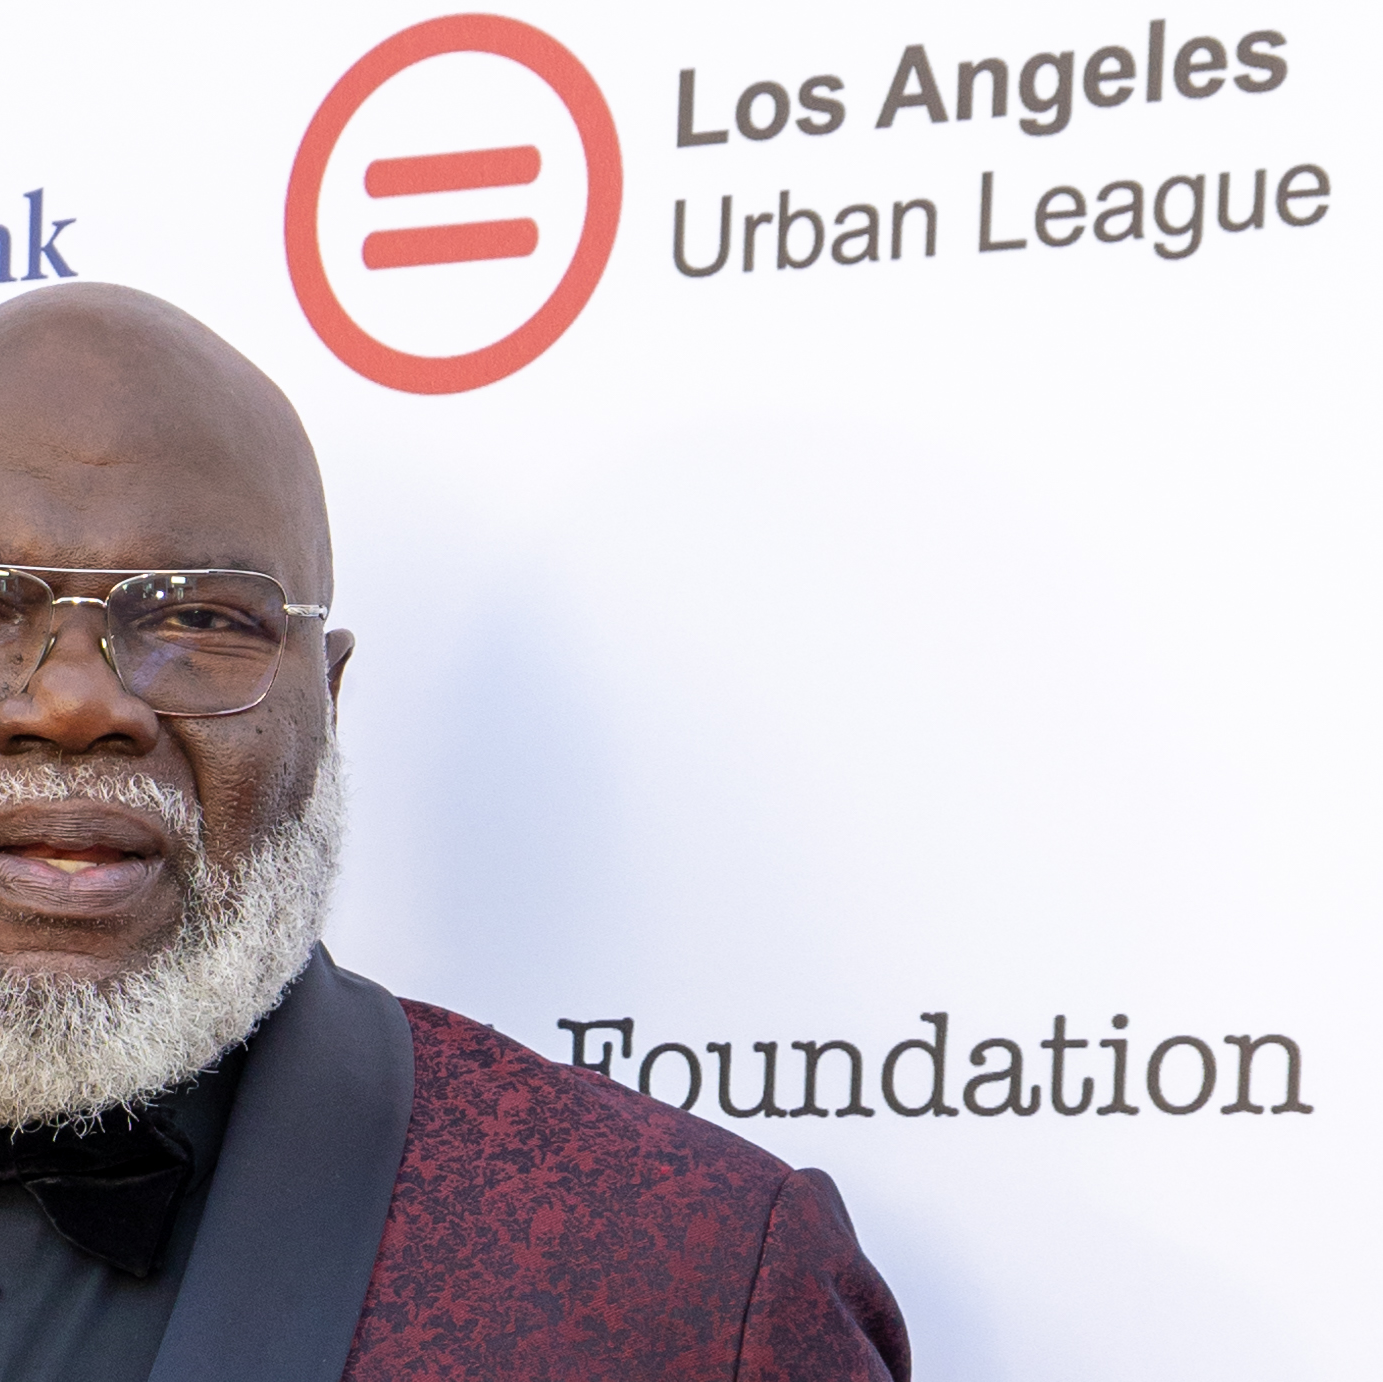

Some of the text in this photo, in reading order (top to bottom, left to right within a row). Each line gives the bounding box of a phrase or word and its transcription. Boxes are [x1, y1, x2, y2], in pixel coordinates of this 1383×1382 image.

[675, 18, 1289, 149] Los Angeles
[672, 162, 1332, 279] Urban League
